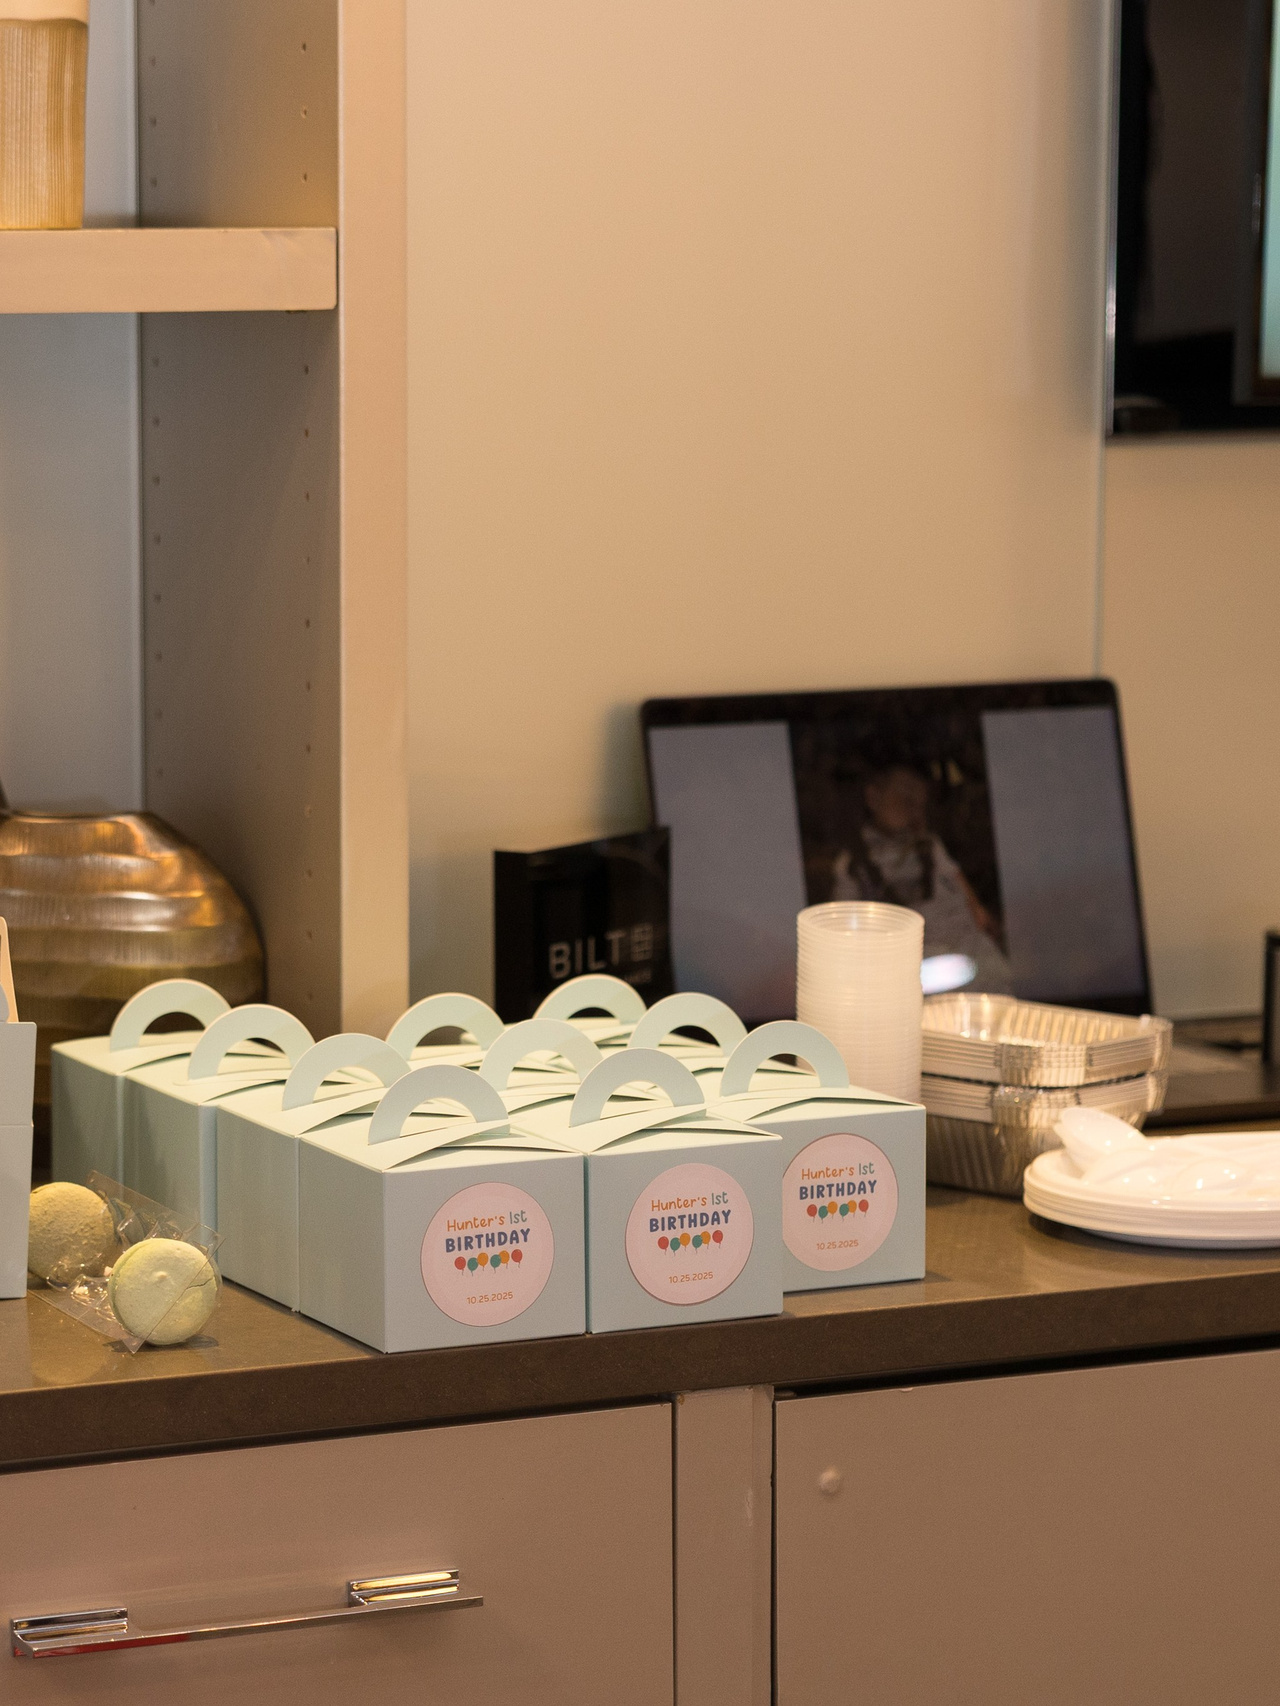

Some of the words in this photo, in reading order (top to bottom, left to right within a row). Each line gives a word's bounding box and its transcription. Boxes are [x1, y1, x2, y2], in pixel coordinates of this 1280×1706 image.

[548, 929, 627, 979] BILT
[801, 1166, 855, 1180] Hunter's
[798, 1179, 878, 1201] BIRTHDAY
[651, 1196, 708, 1212] Hunter's
[446, 1215, 505, 1232] Hunter's
[648, 1208, 732, 1234] BIRTHDAY
[444, 1227, 531, 1254] BIRTHDAY
[816, 1239, 859, 1250] 10.25.2025
[669, 1271, 714, 1284] 10.25.2025
[466, 1291, 514, 1305] 10.25.2025
